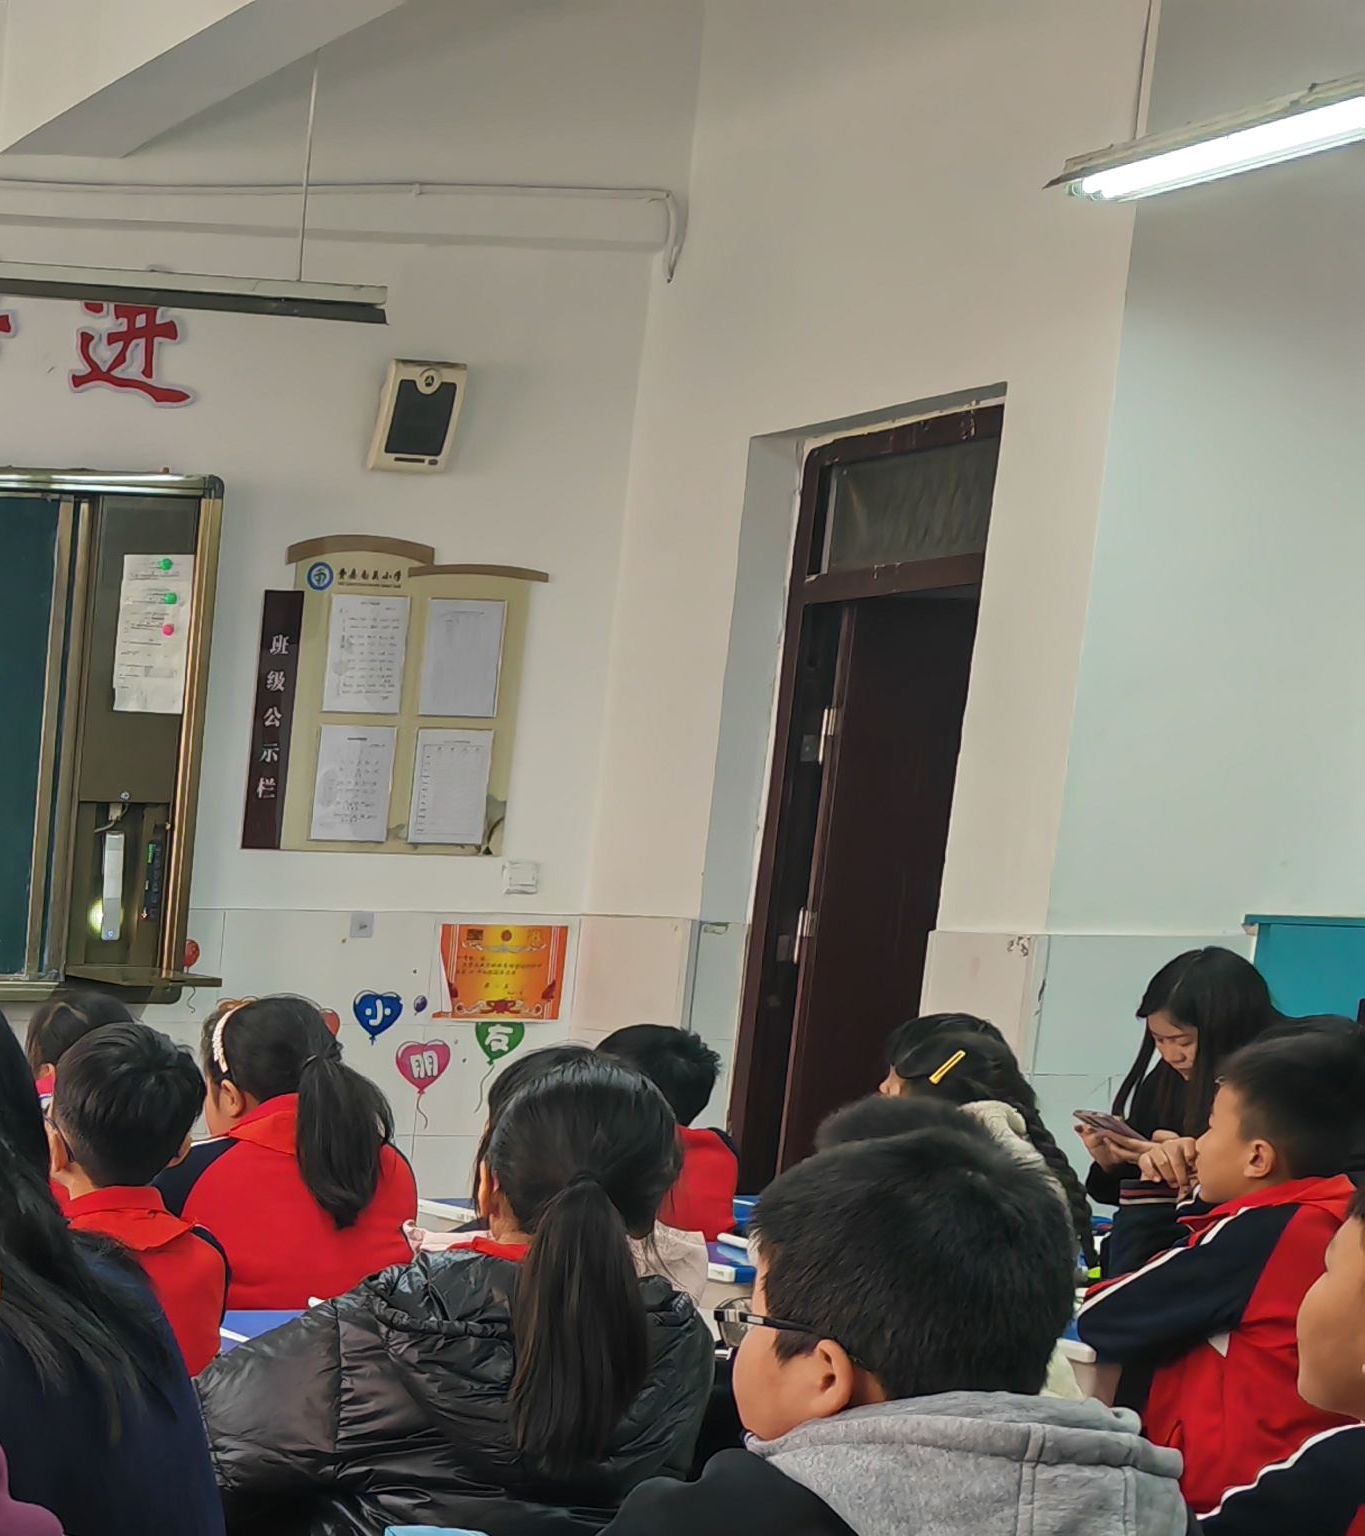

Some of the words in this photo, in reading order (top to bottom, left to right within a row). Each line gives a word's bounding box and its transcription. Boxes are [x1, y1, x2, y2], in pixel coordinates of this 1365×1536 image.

[256, 633, 291, 799] 班级公示栏
